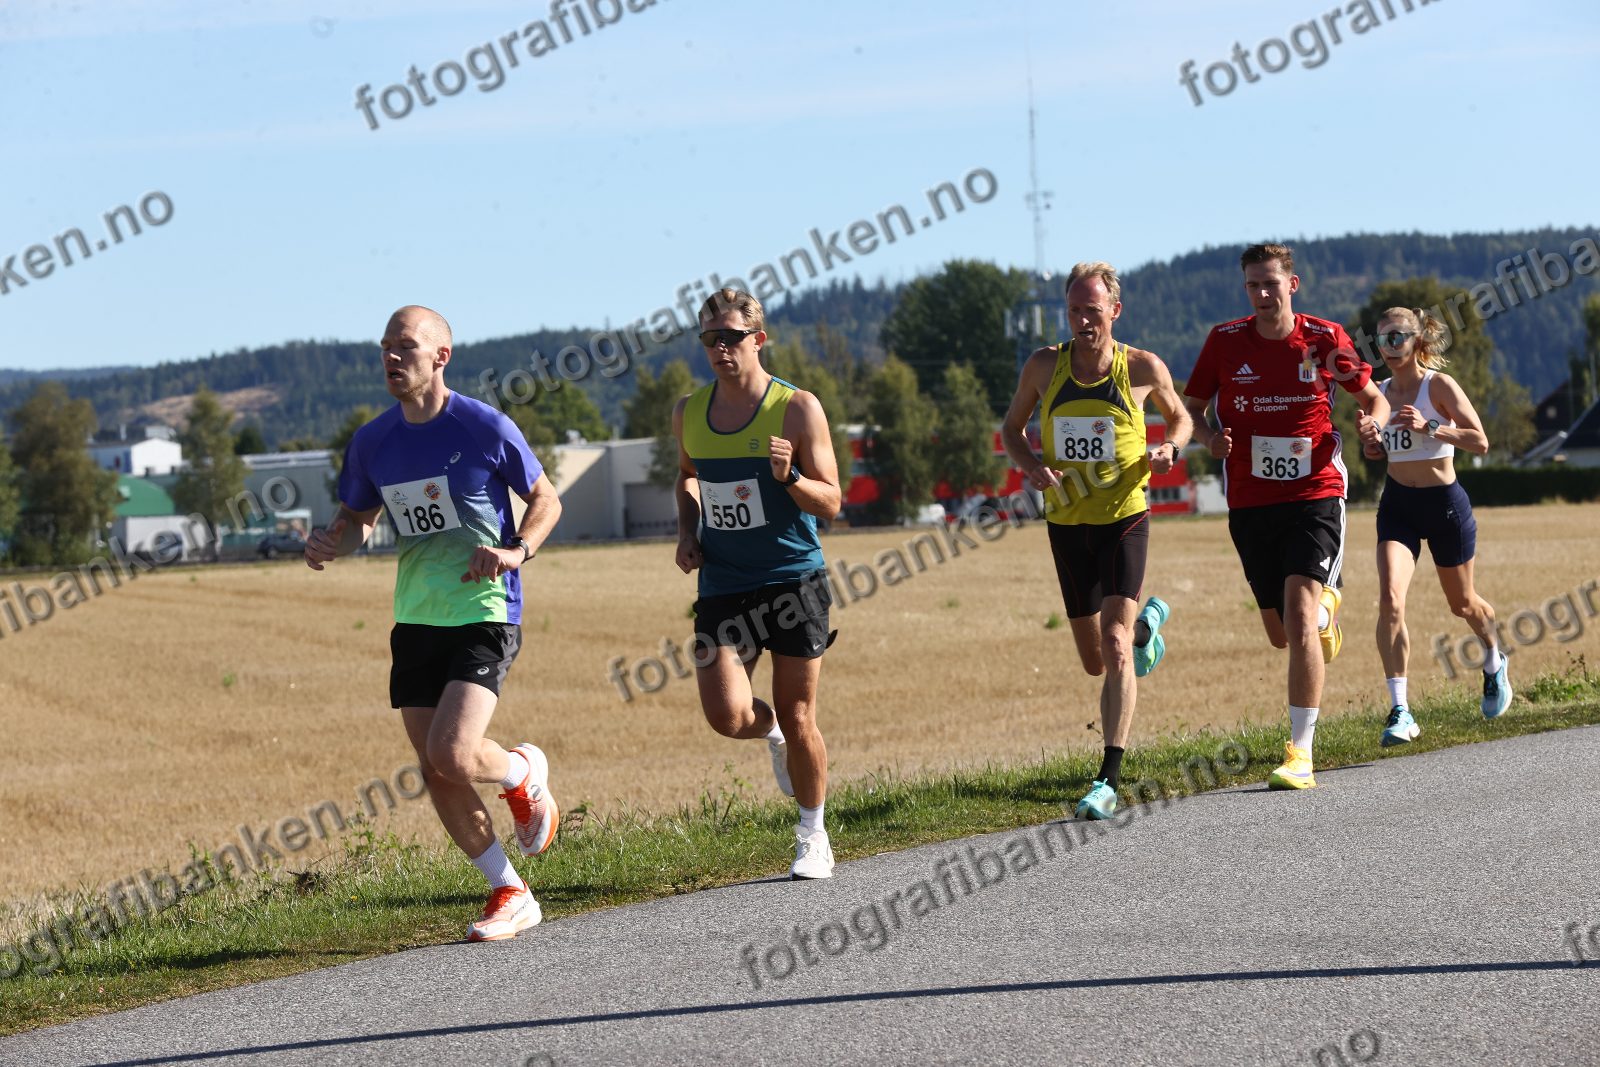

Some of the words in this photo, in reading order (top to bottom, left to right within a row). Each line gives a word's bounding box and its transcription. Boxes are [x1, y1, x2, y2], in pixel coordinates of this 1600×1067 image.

[1253, 396, 1272, 404] Odal
[1064, 436, 1104, 461] 838
[1262, 456, 1299, 478] 363
[402, 503, 446, 534] 186
[711, 502, 751, 528] 550
